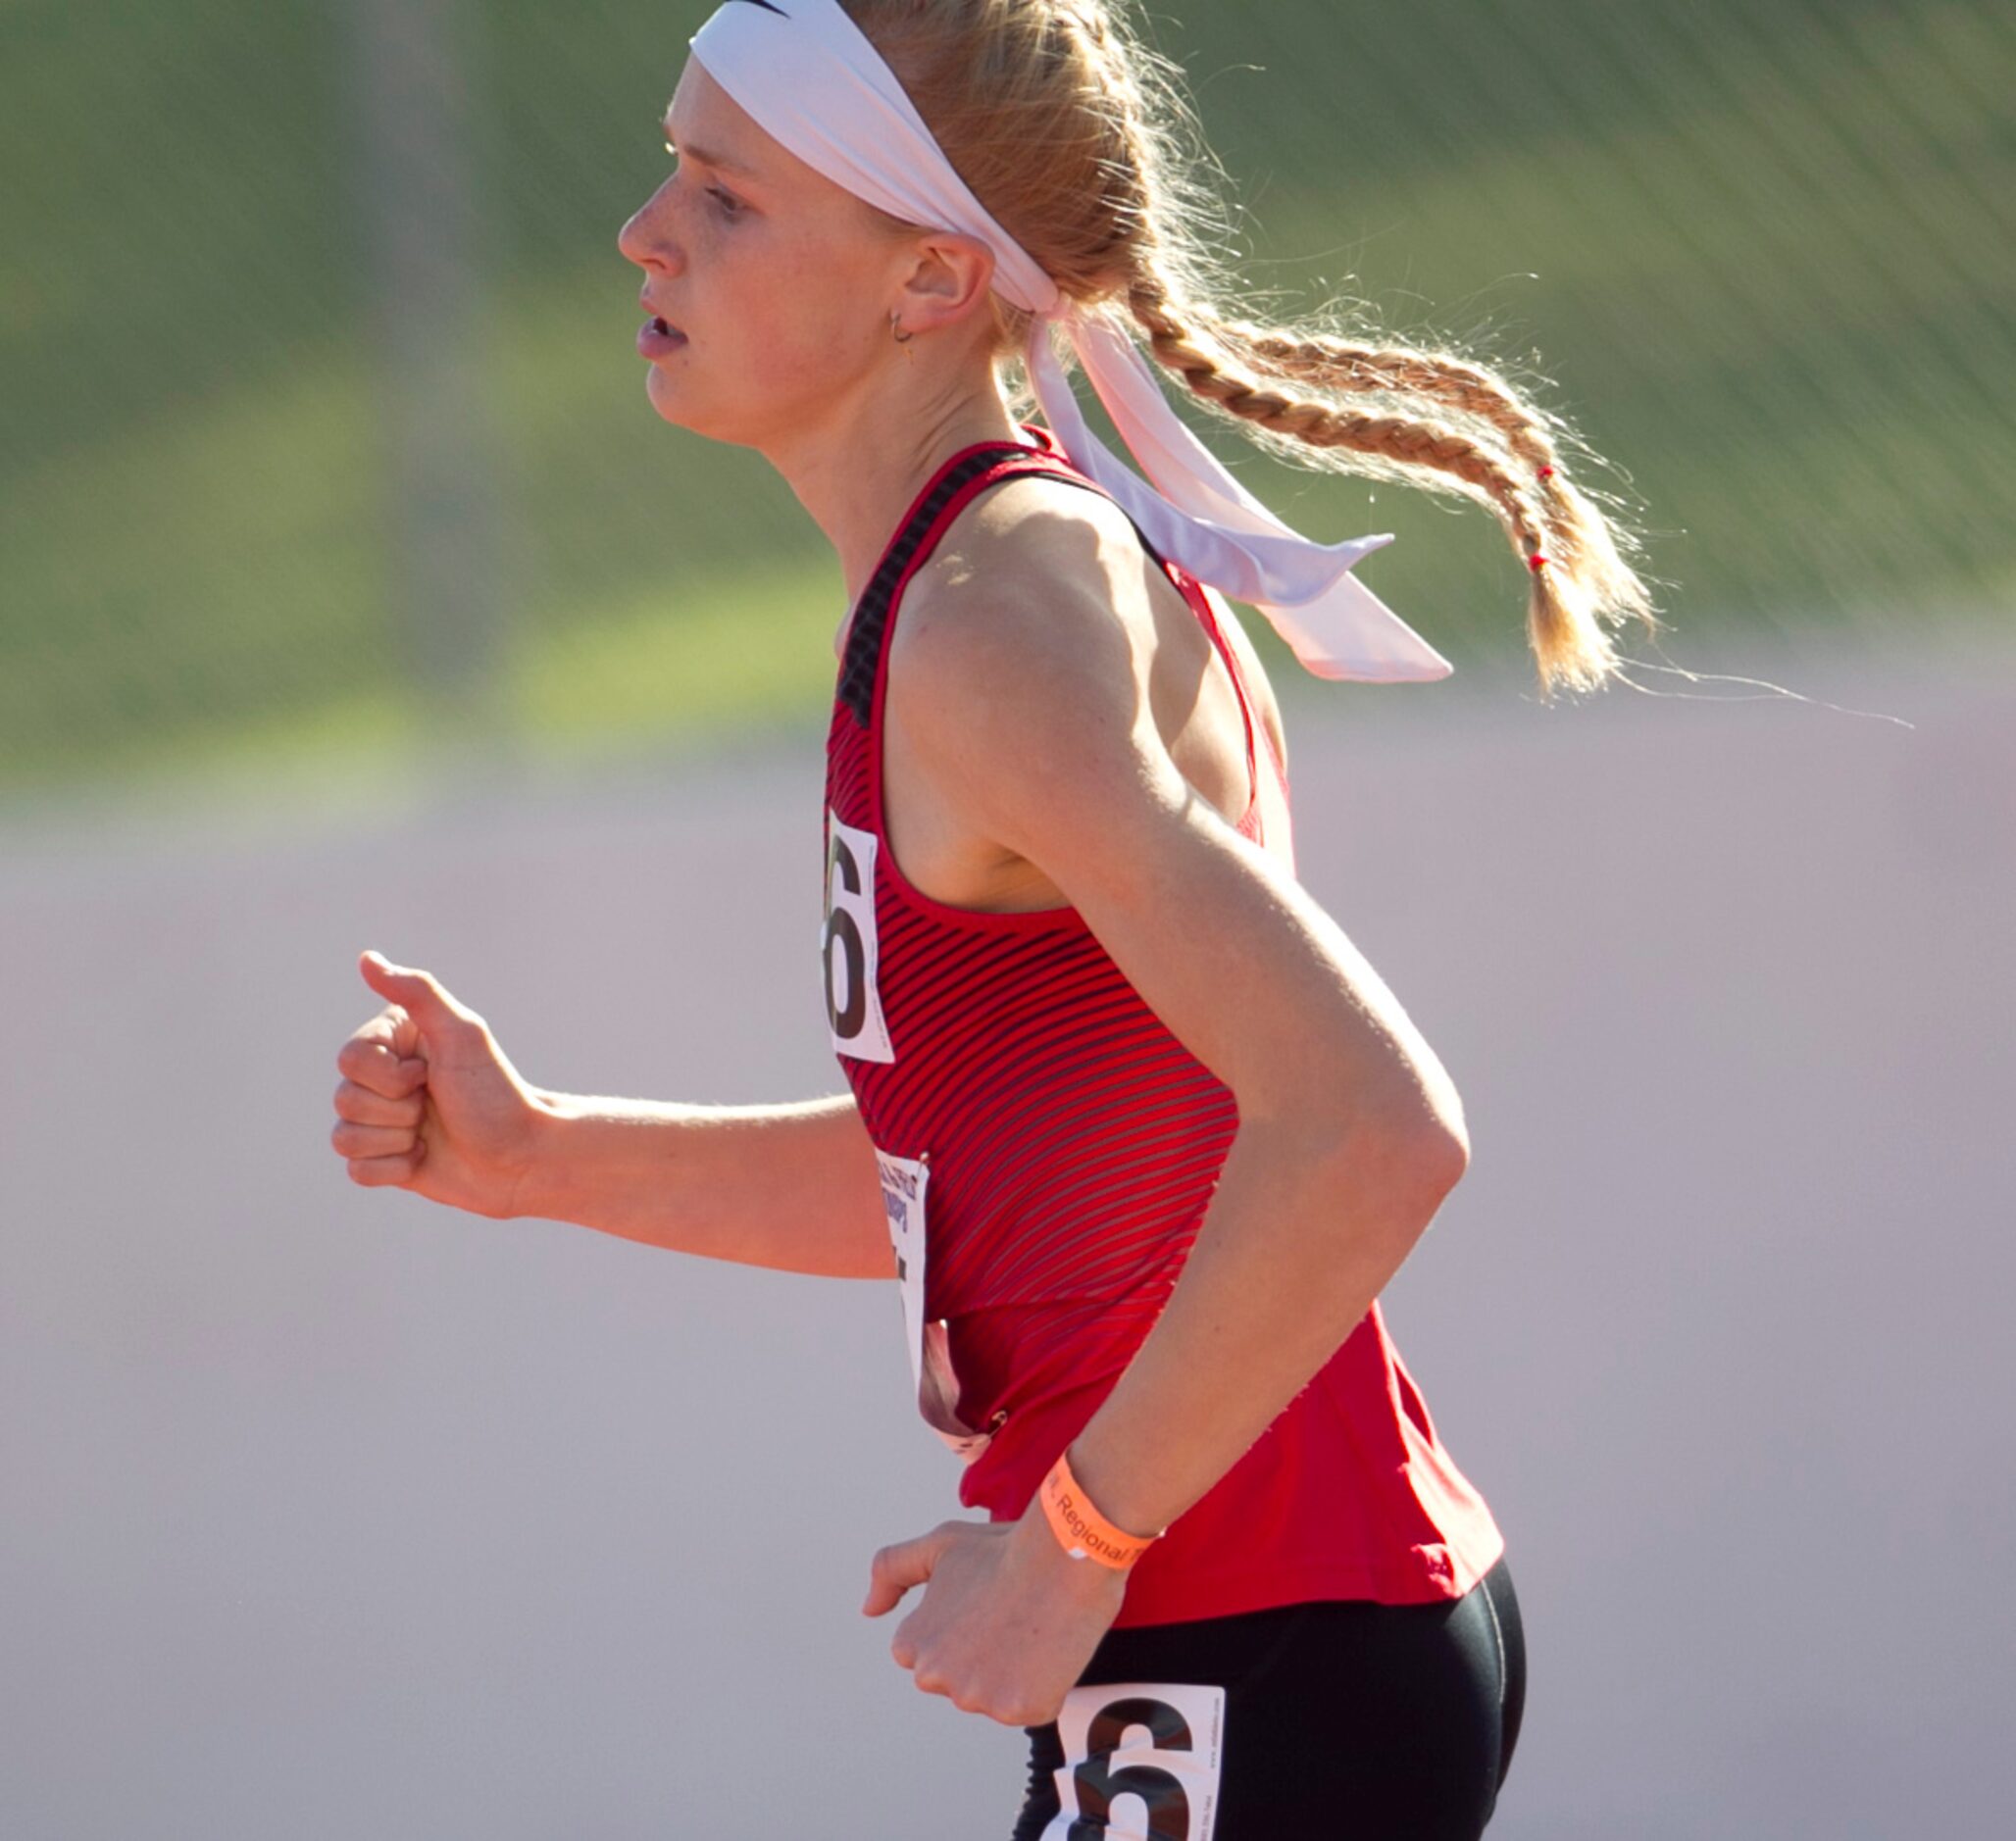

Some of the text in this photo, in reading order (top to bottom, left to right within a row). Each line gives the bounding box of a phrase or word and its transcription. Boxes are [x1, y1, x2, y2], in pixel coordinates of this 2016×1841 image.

[824, 833, 866, 1040] 6
[1056, 1493, 1129, 1563] Regional
[1066, 1697, 1193, 1841] 6
